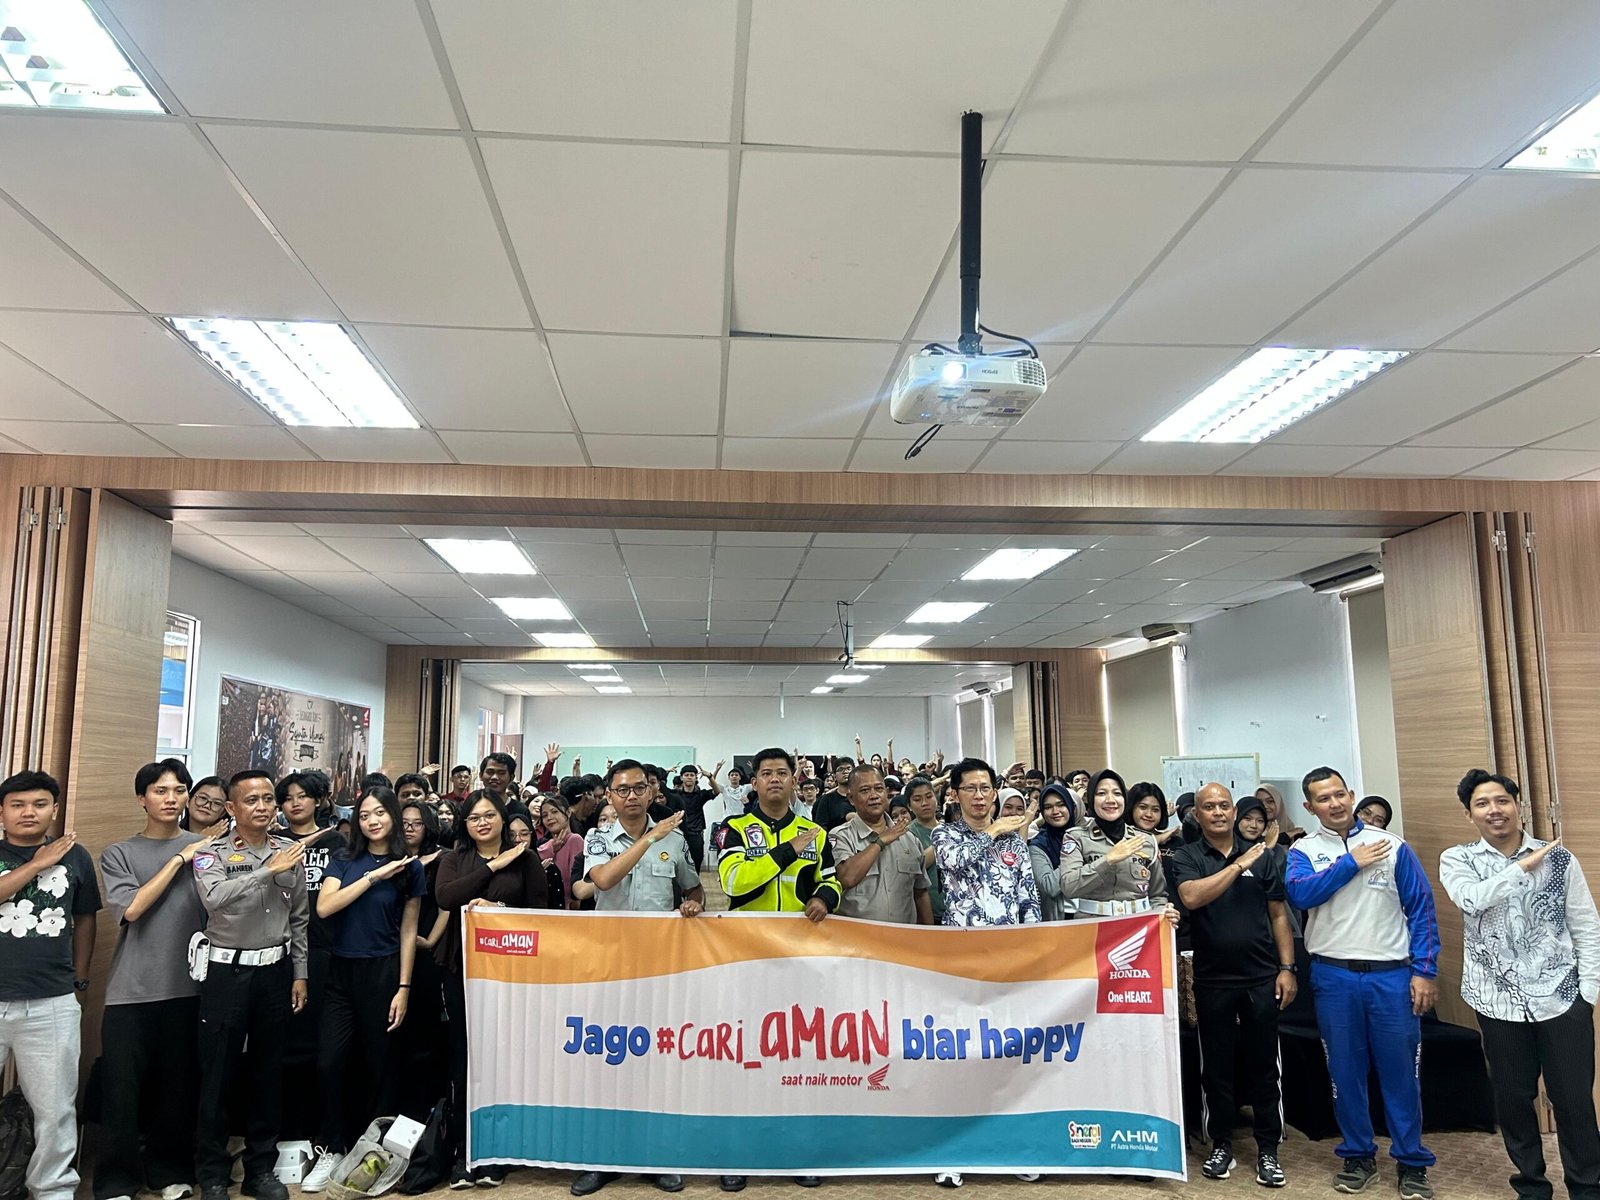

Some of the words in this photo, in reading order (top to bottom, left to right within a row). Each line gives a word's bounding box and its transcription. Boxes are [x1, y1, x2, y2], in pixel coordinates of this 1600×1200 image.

[1109, 969, 1151, 979] HONDA
[1107, 991, 1124, 1003] One
[563, 1016, 651, 1066] Jago
[902, 1014, 971, 1060] biar
[979, 1018, 1085, 1064] happy
[781, 1073, 802, 1086] saat
[805, 1073, 827, 1086] naik
[830, 1074, 863, 1086] motor
[1111, 1130, 1158, 1143] AHM
[1144, 1144, 1158, 1152] Motor
